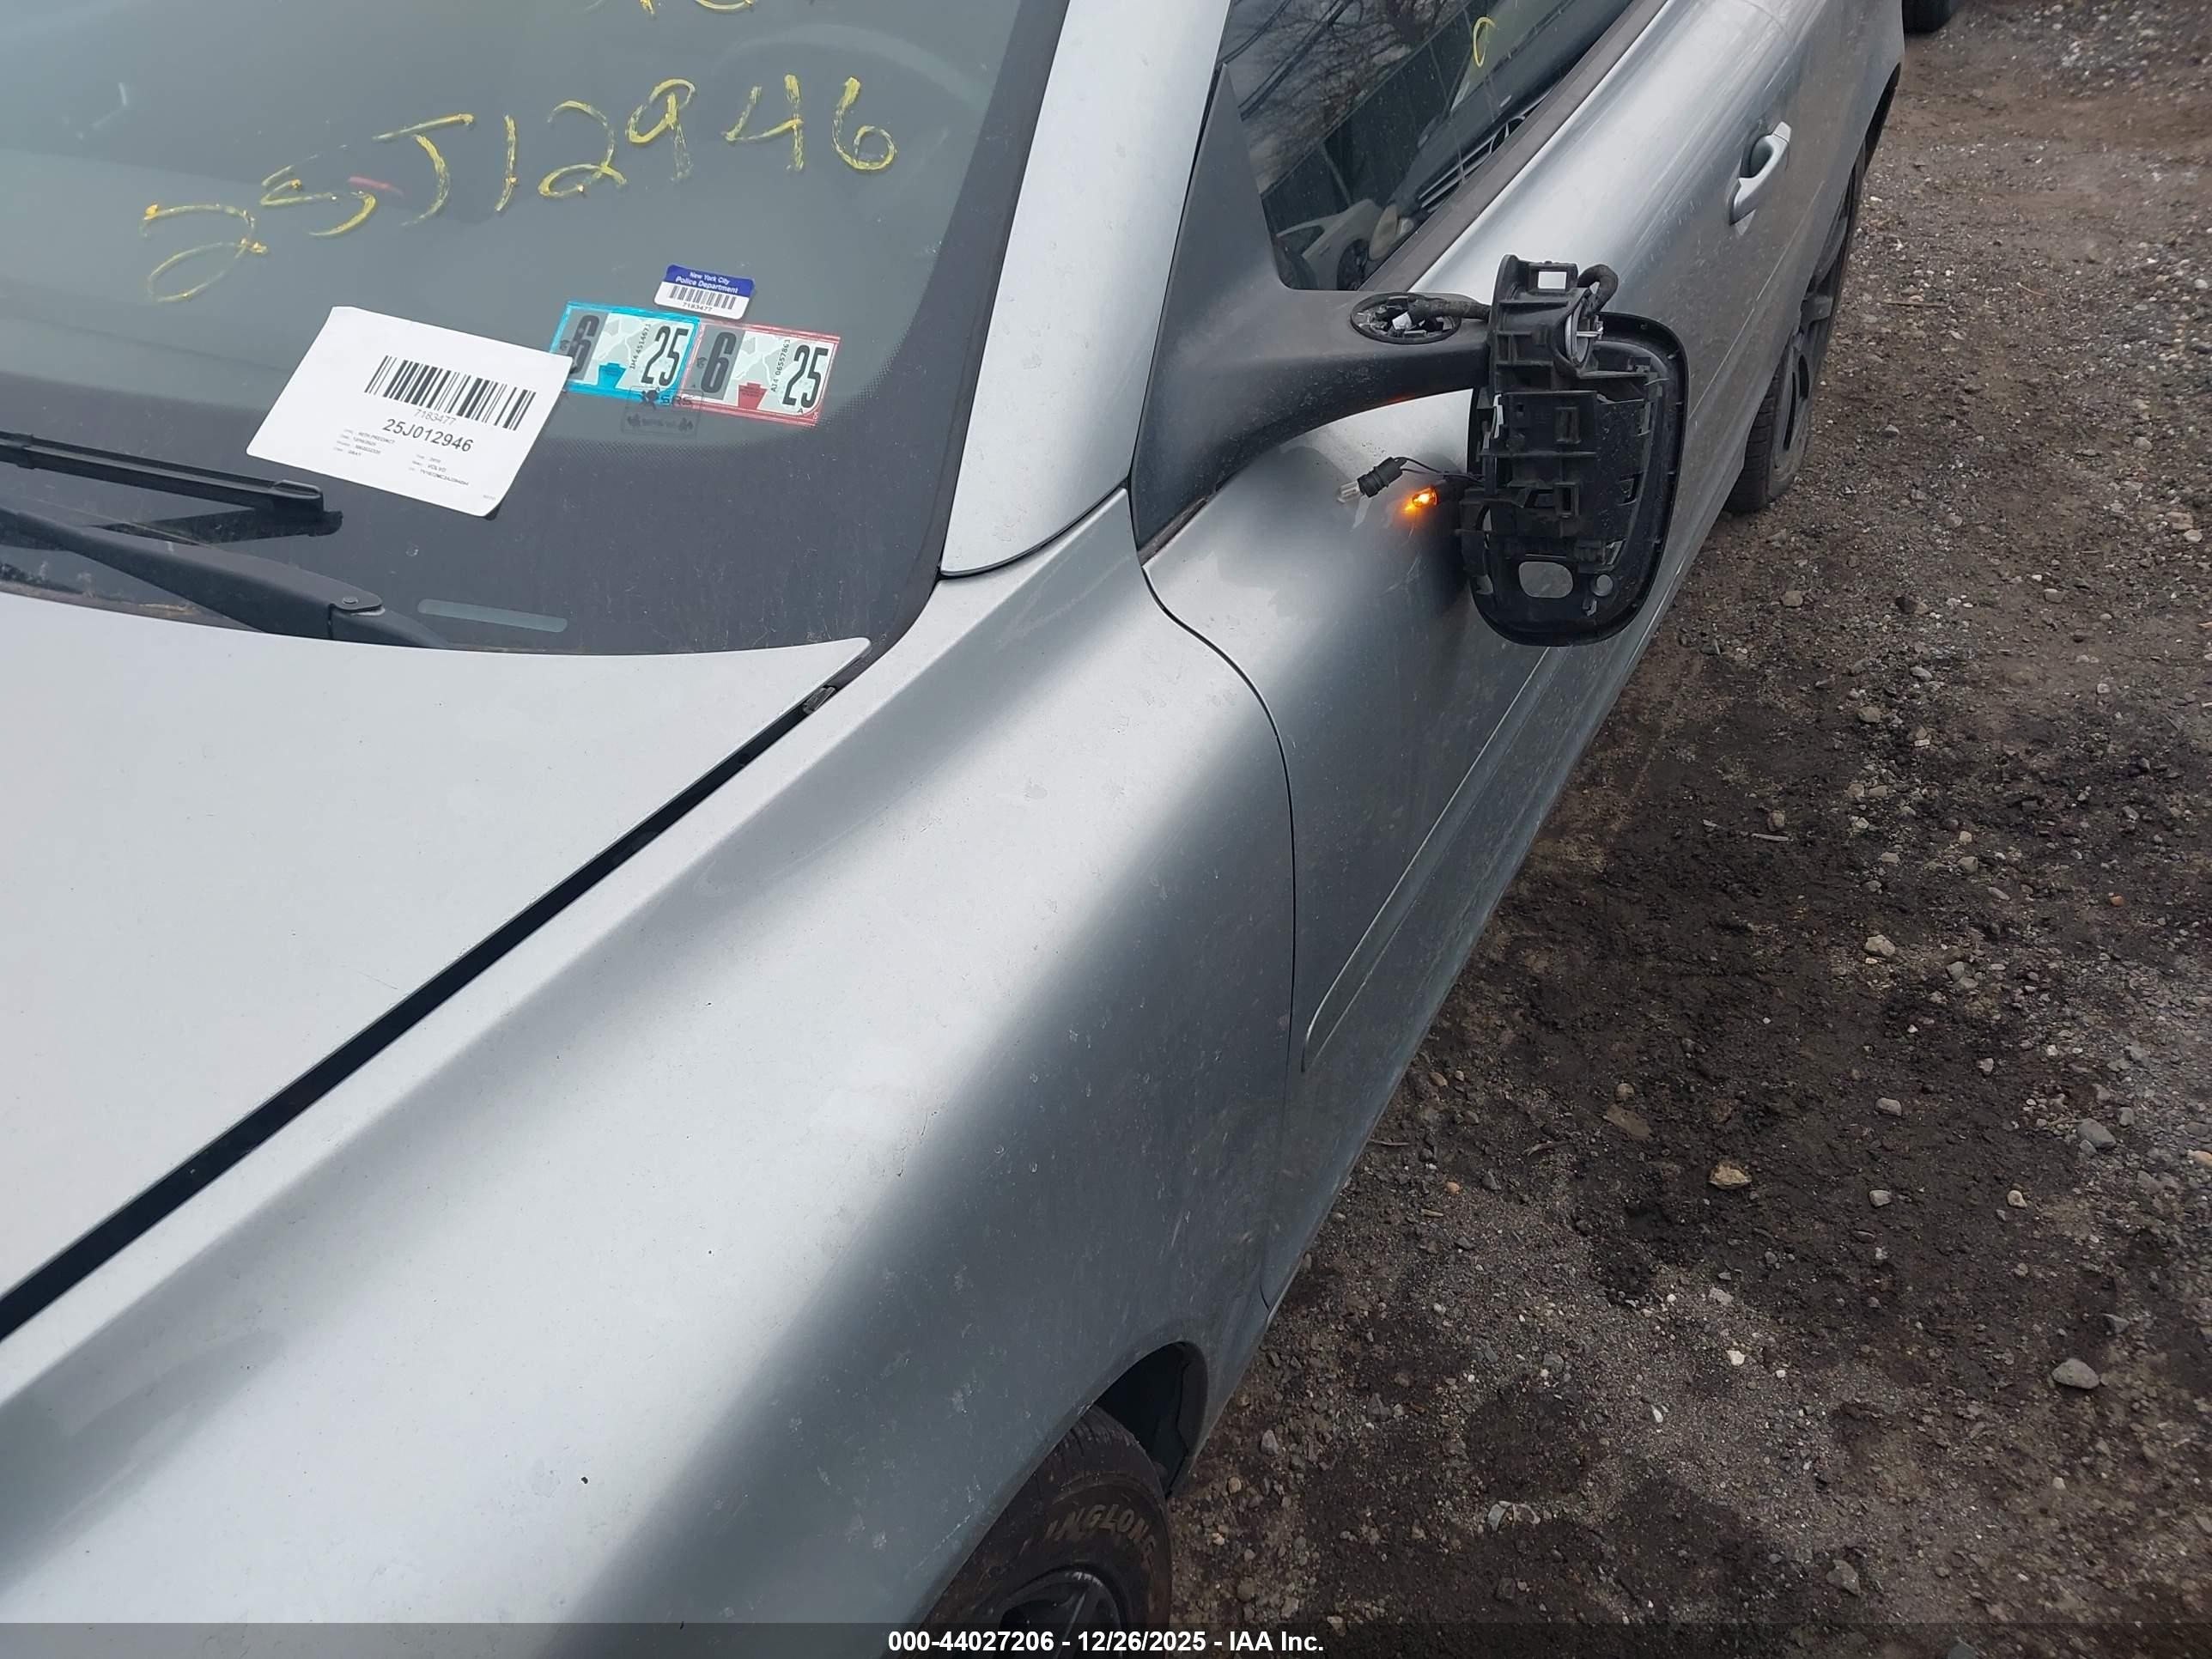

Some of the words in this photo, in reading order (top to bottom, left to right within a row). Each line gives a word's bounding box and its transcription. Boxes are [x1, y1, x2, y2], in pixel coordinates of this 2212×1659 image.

[675, 276, 696, 285] Police
[697, 280, 738, 294] Department
[717, 276, 730, 285] City
[683, 302, 713, 312] 7183477
[568, 314, 599, 374] 6
[641, 325, 689, 386] 25
[700, 331, 737, 393] 6
[782, 344, 829, 408] 25
[382, 418, 474, 452] 25J012946
[413, 409, 457, 427] 7183477
